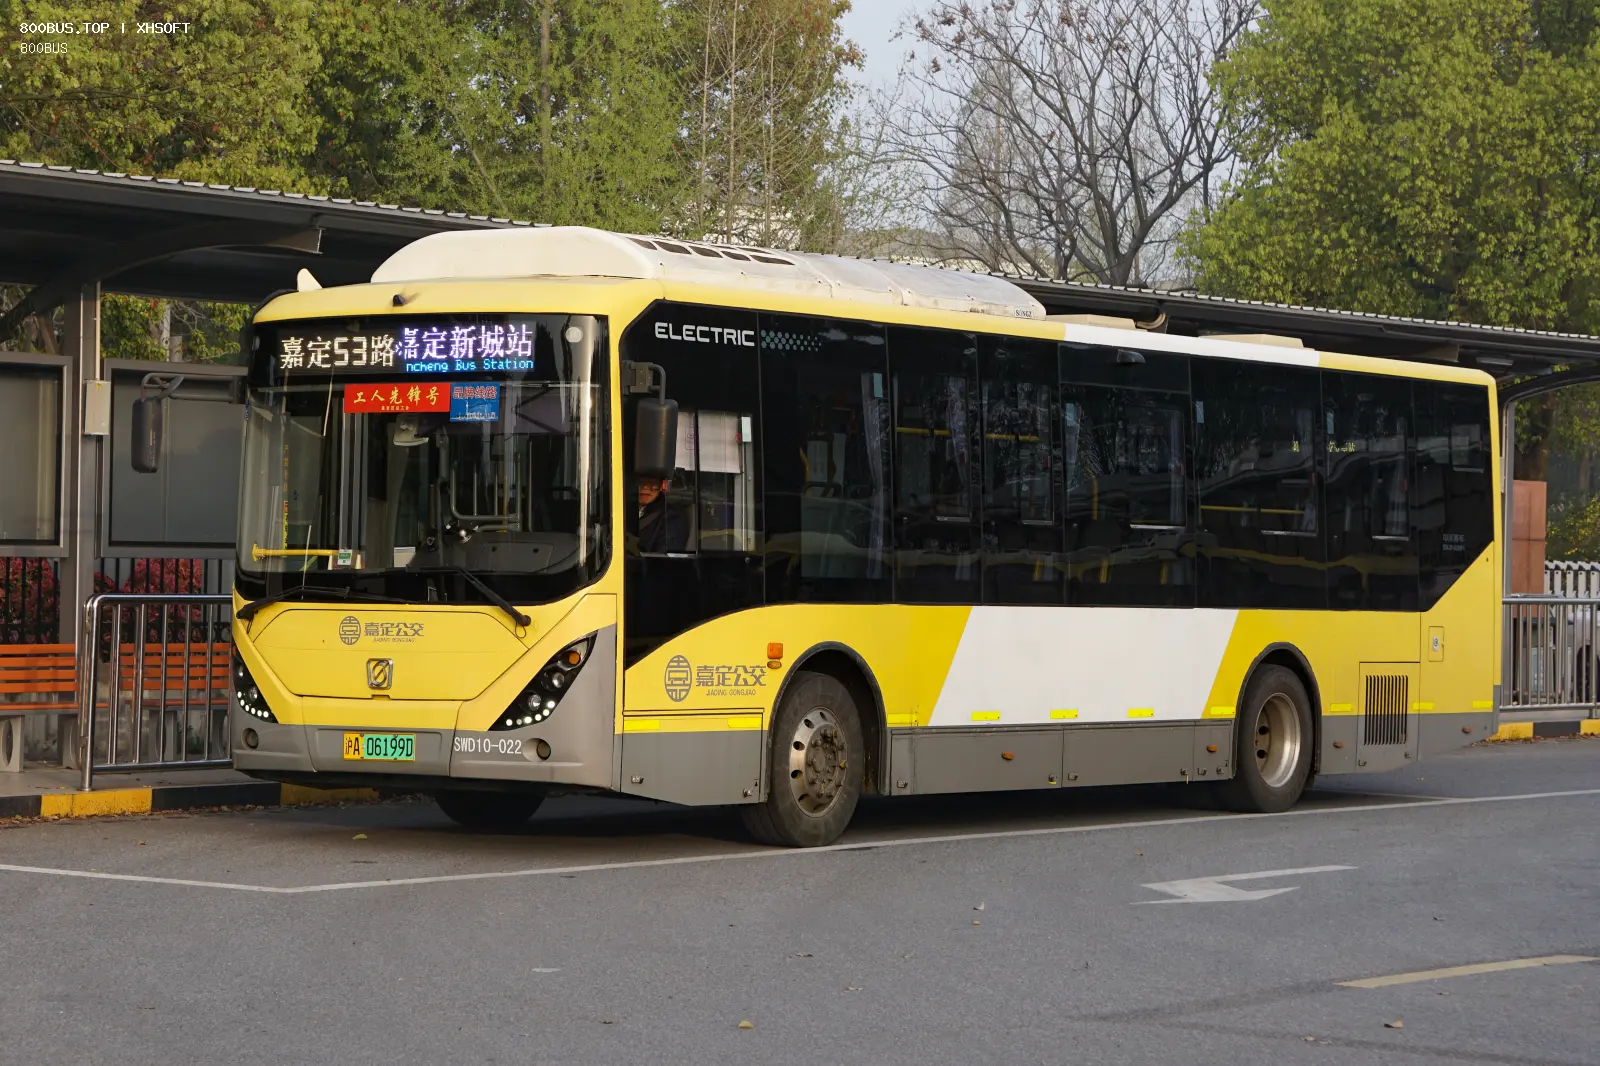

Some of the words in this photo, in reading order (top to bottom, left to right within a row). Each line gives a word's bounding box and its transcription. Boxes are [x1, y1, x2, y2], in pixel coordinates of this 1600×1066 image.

[654, 321, 756, 347] ELECTRIC
[280, 334, 395, 369] 嘉定53路
[406, 361, 449, 373] ncheng
[455, 359, 476, 371] Bus
[483, 357, 534, 370] Station
[353, 385, 440, 406] 工人先锋号
[364, 622, 425, 637] 嘉定公交
[695, 664, 767, 687] 嘉定公交
[366, 736, 414, 758] 06199D
[453, 736, 523, 755] SWD10-022
